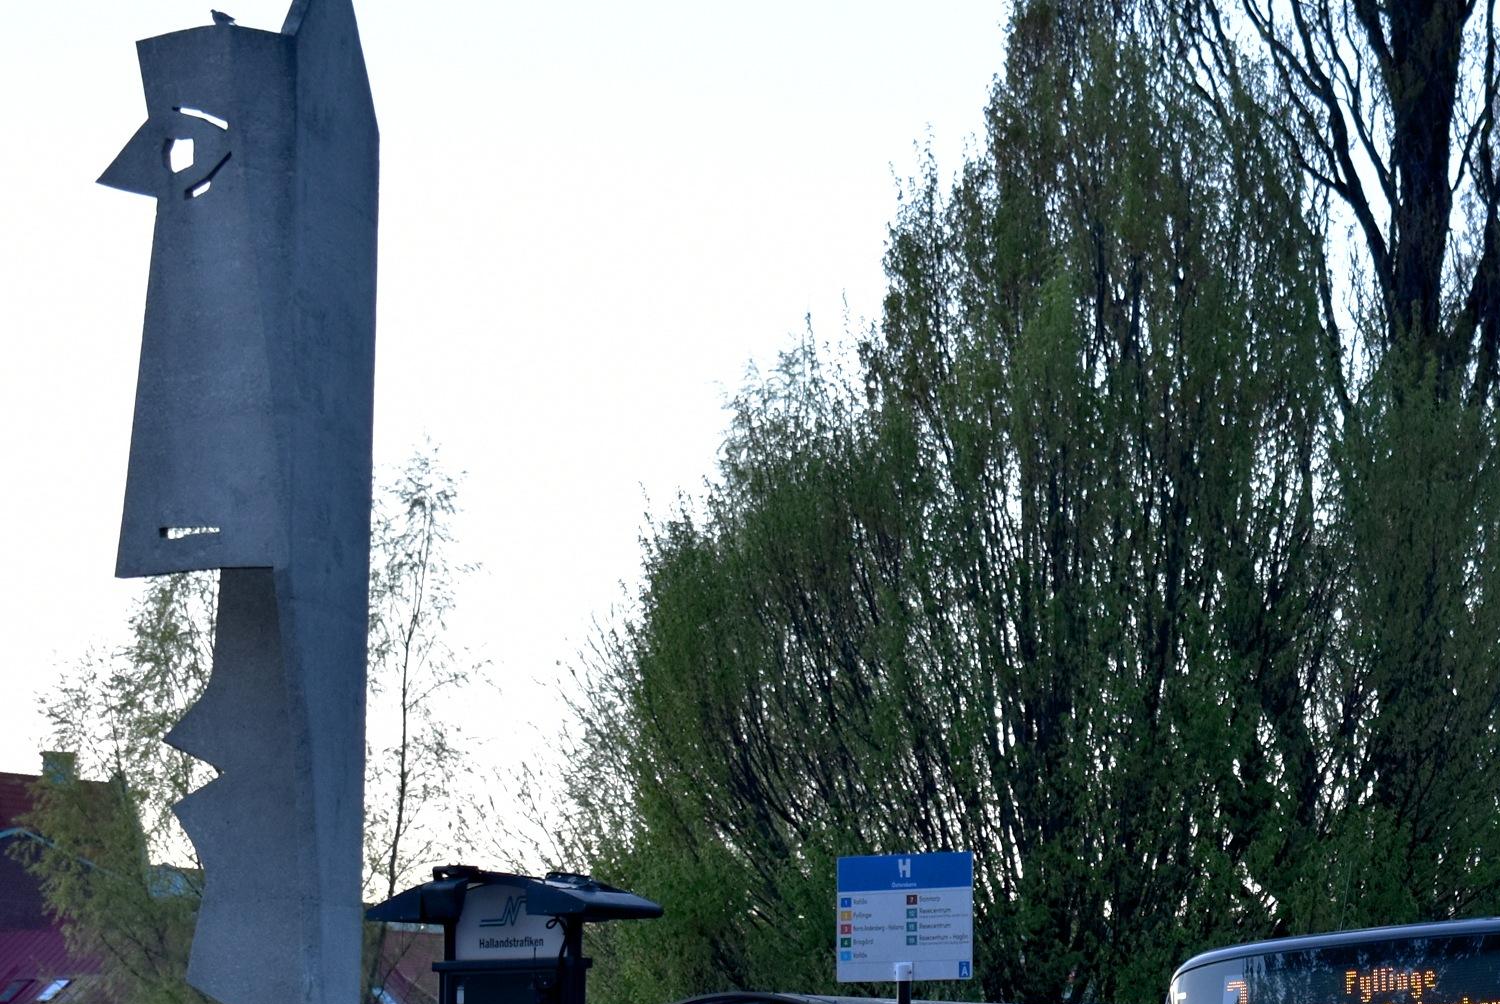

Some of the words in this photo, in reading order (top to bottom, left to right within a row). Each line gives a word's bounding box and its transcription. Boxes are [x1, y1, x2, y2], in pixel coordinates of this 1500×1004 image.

[898, 858, 911, 878] H
[479, 936, 544, 949] Hallandstrafiken
[960, 966, 969, 976] A
[1345, 967, 1436, 1003] Fyllinge
